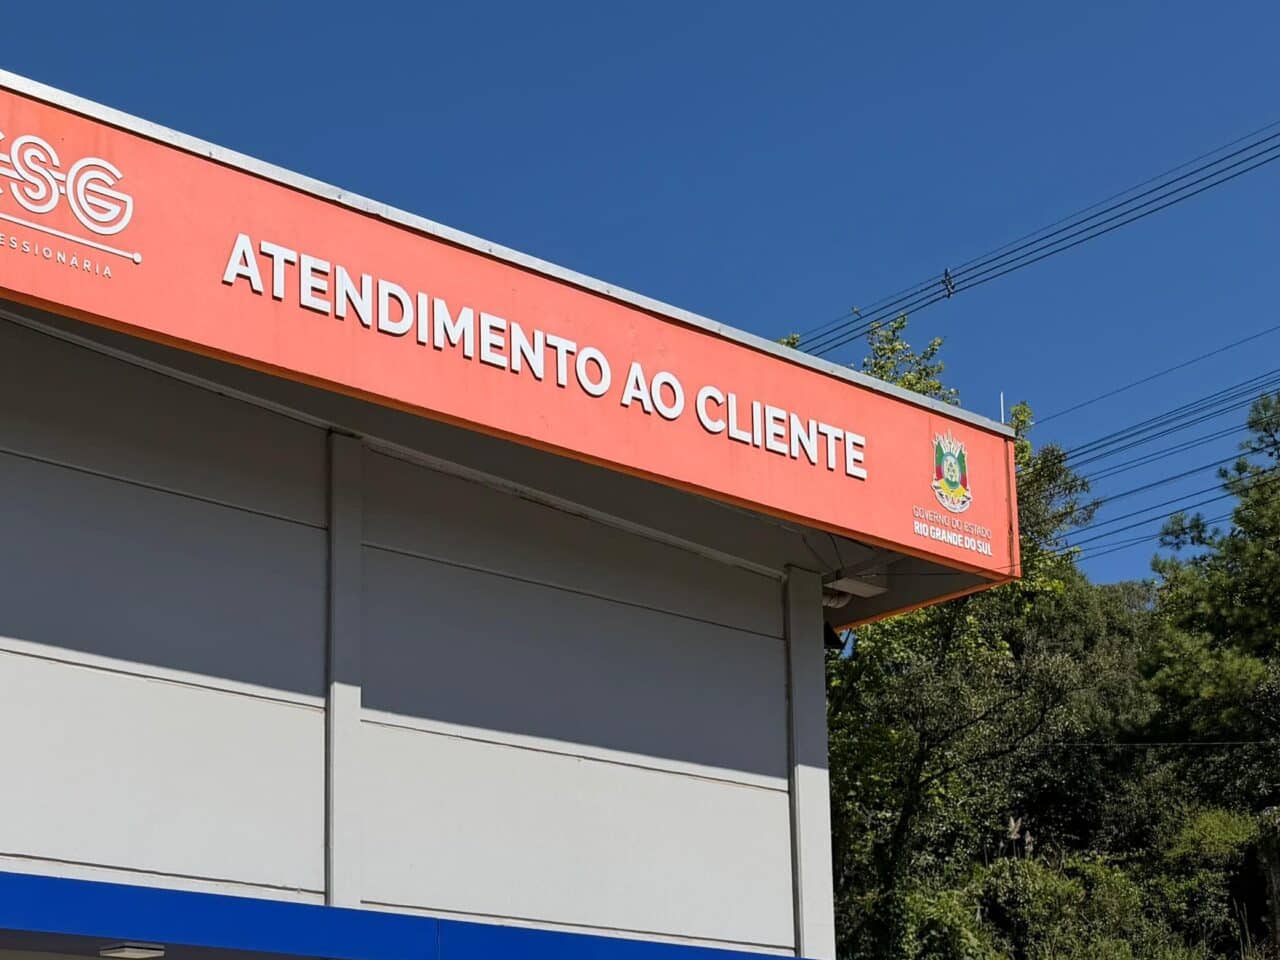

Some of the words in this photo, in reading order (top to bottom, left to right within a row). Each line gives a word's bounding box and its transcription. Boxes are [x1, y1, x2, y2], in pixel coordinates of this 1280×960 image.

[223, 233, 612, 396] ATENDIMENTO
[621, 361, 685, 420] AO
[696, 385, 868, 480] CLIENTE
[912, 504, 950, 527] GOVERNO
[951, 518, 963, 530] DO
[964, 521, 993, 540] ESTADO
[913, 520, 929, 537] RIO
[929, 526, 964, 548] GRANDE
[964, 536, 977, 551] DO
[977, 540, 993, 557] SUL
